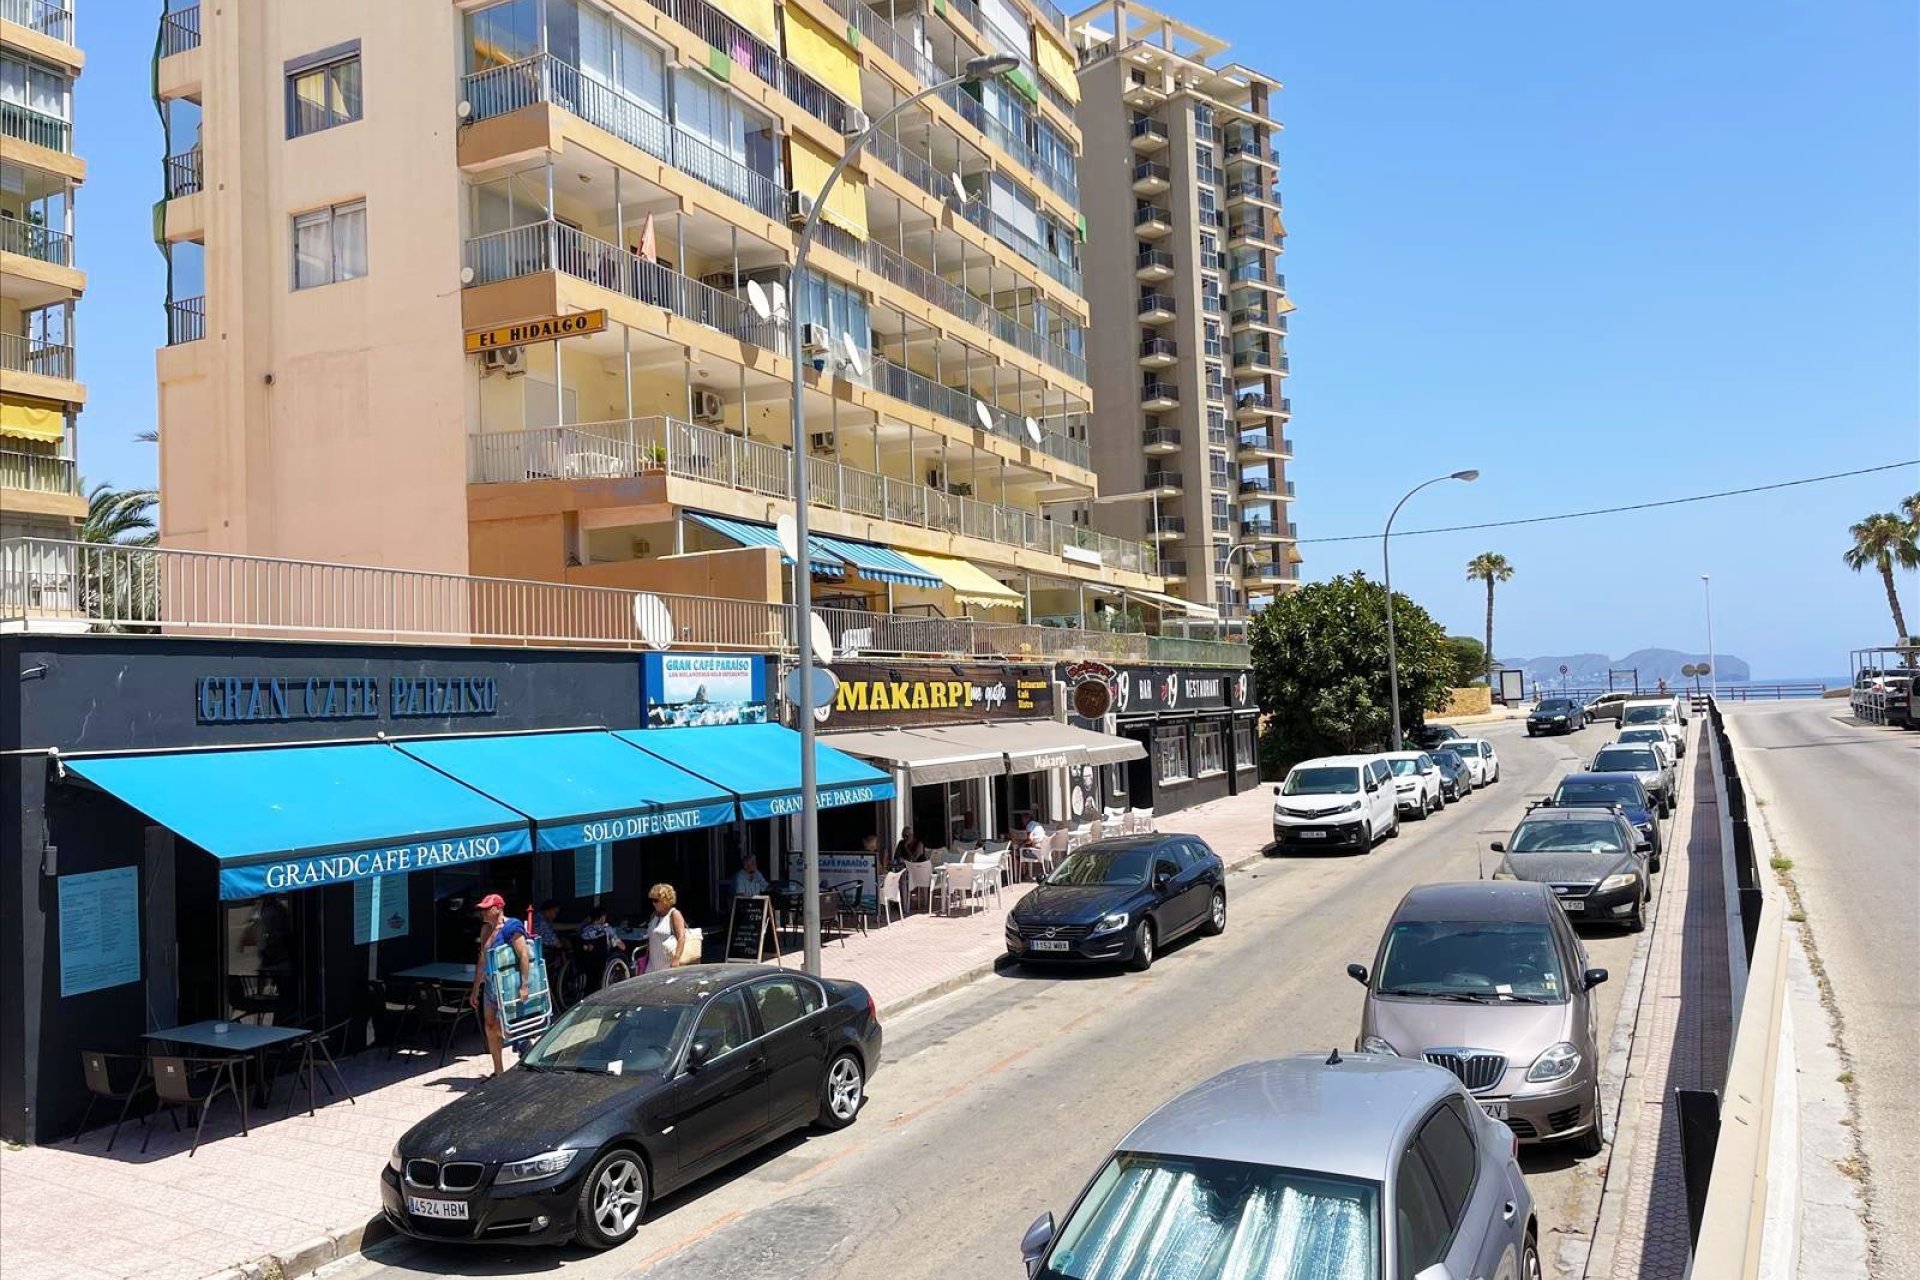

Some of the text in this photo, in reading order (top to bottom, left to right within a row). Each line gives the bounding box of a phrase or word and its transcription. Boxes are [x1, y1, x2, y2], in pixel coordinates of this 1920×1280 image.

[480, 316, 587, 346] EL HIDALGO
[666, 660, 691, 671] GRAN
[202, 676, 289, 719] GRAN
[390, 676, 497, 714] PARAISO
[836, 681, 973, 711] MAKARPI
[1116, 671, 1129, 712] 19
[1139, 680, 1152, 699] BAR
[1166, 673, 1178, 709] 19
[1185, 679, 1219, 698] RESTAURANT
[834, 786, 874, 807] PARAISO
[583, 810, 700, 842] SOLO DIFERENTE
[266, 836, 500, 889] GRANDCAFE PARAISO
[414, 1199, 466, 1217] 4524 HBM
